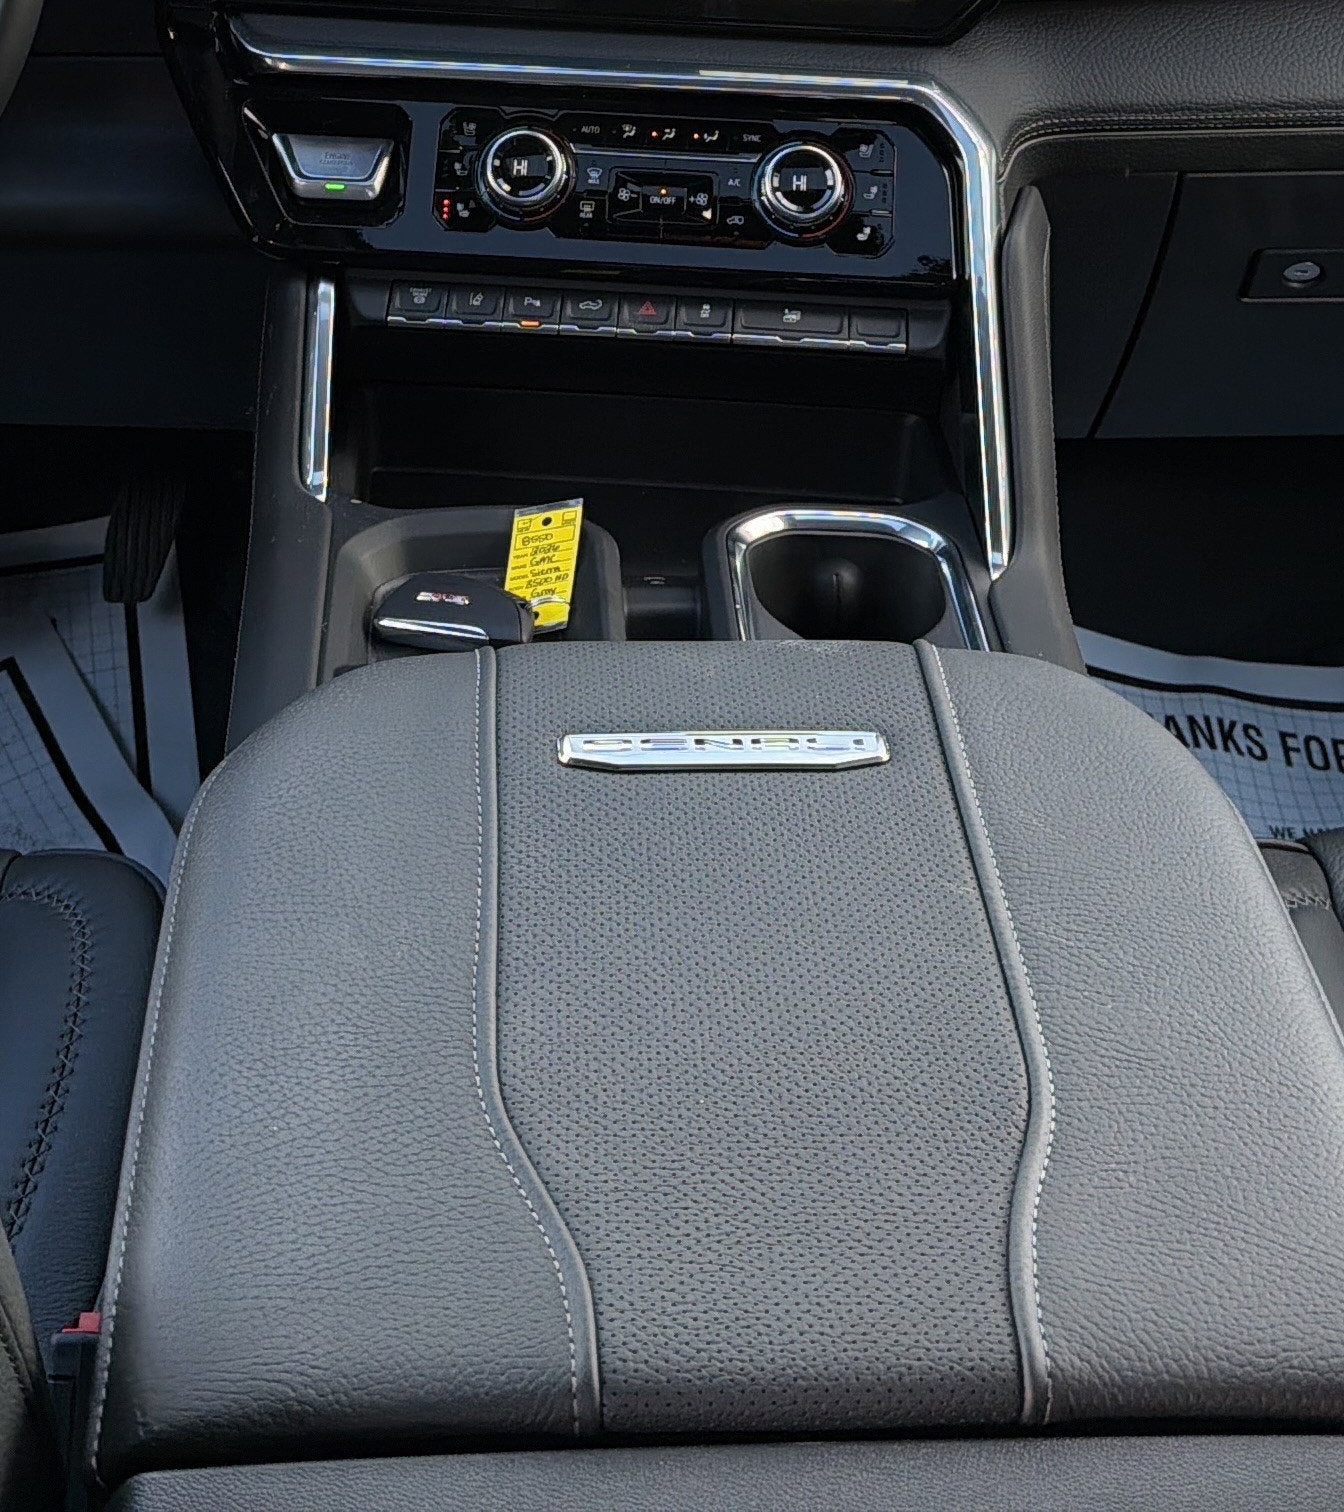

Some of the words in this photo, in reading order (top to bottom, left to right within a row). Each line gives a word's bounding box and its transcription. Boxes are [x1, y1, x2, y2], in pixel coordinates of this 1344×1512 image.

[581, 125, 600, 134] AUTO
[512, 158, 529, 176] HI
[792, 175, 807, 192] HI
[1147, 711, 1268, 762] ANKS
